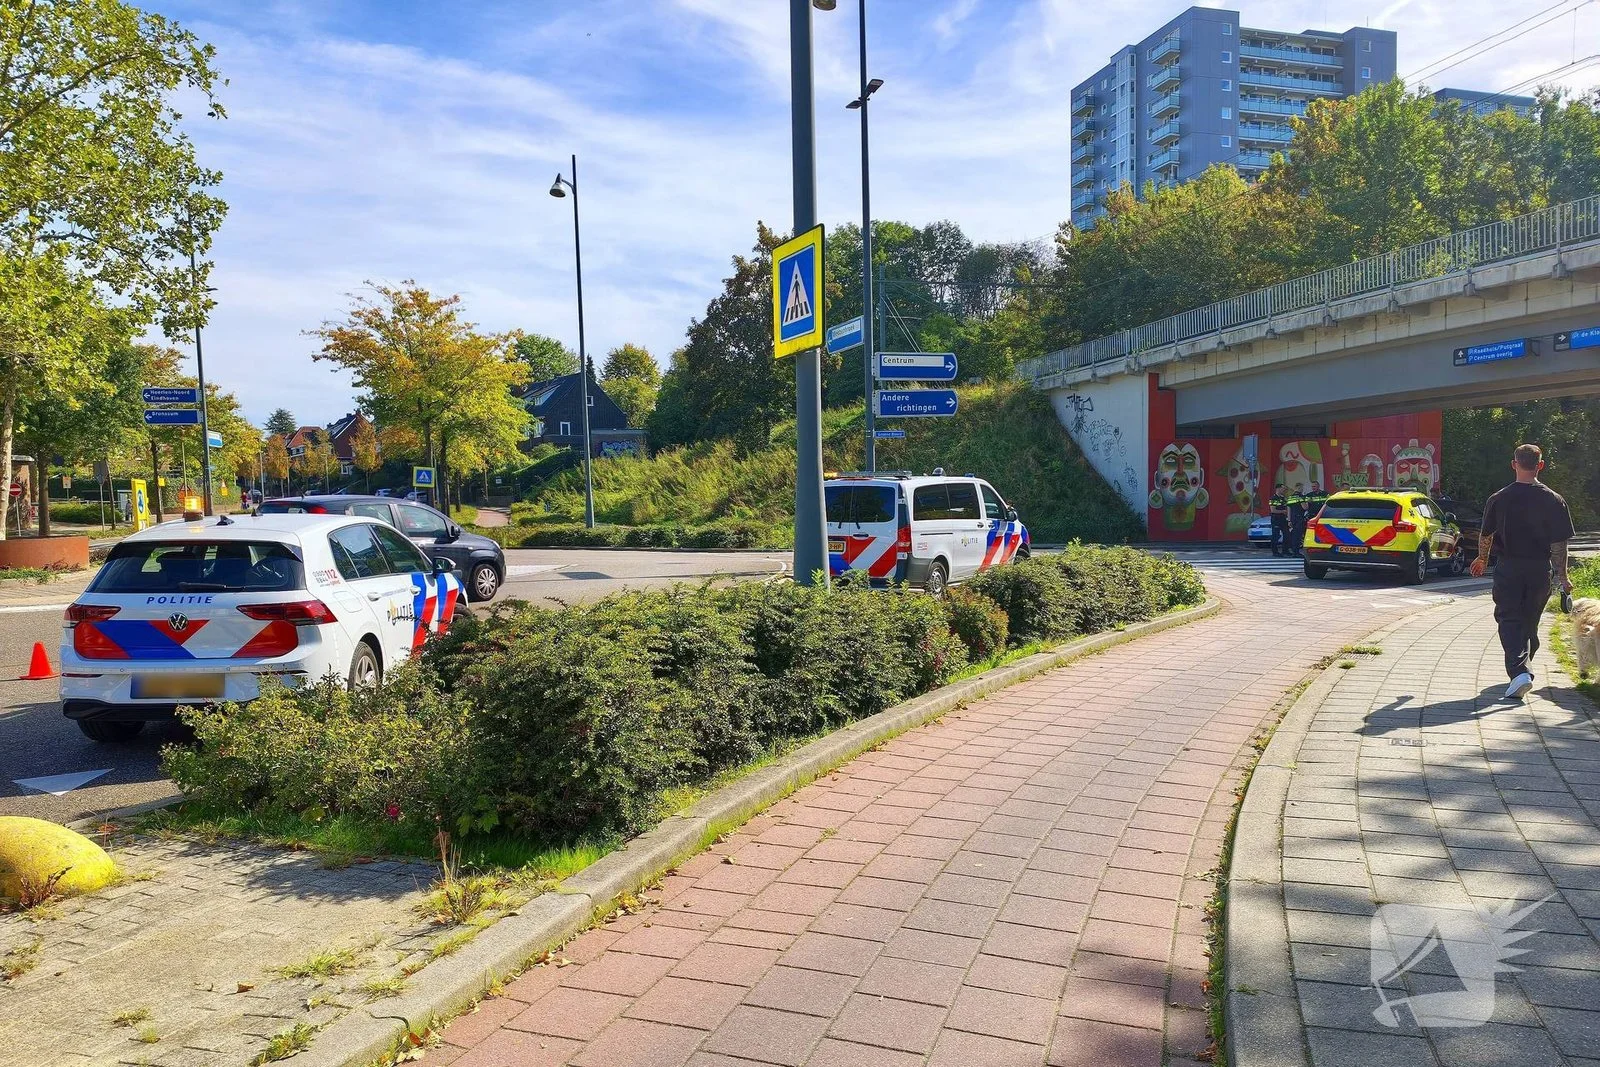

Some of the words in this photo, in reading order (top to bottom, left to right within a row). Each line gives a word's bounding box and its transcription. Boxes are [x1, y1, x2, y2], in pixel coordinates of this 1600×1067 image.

[882, 356, 915, 364] Centrum
[1474, 353, 1496, 361] Centrum
[896, 403, 937, 413] richtingen
[324, 569, 338, 579] 112
[146, 596, 213, 604] POLITIE
